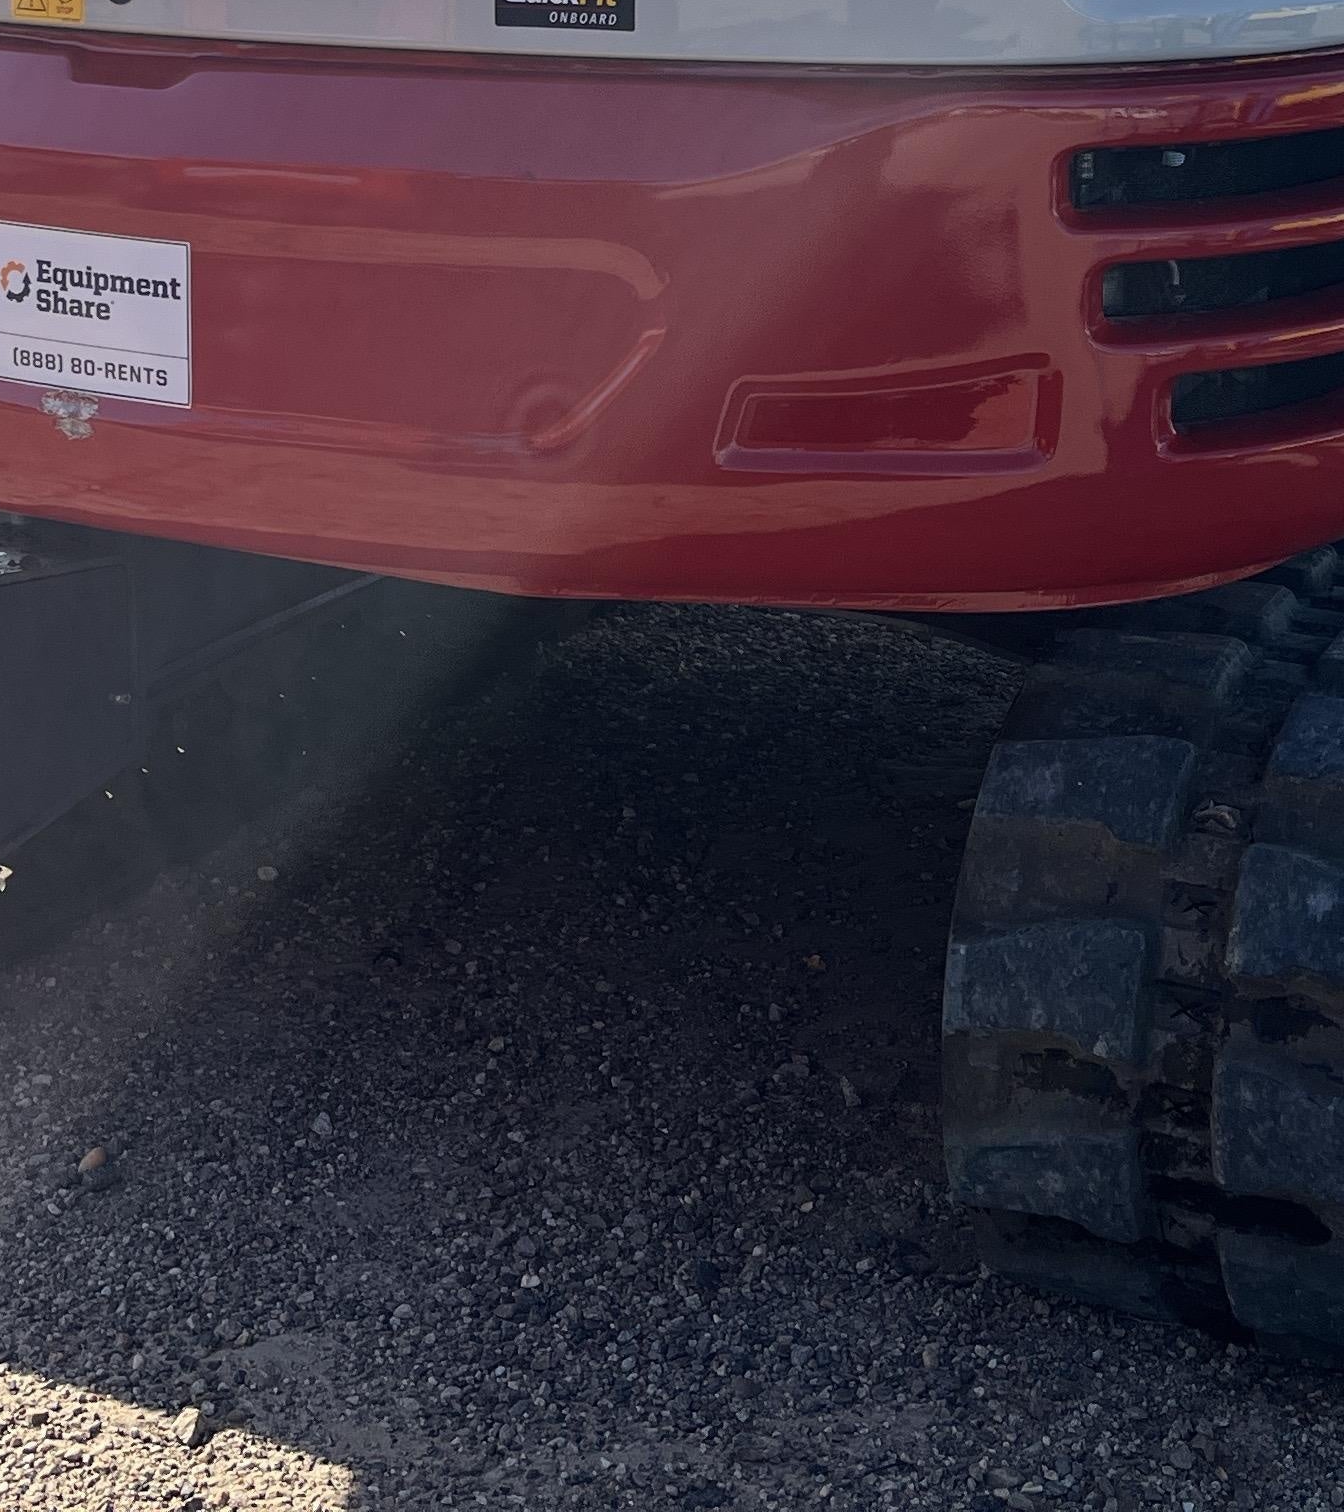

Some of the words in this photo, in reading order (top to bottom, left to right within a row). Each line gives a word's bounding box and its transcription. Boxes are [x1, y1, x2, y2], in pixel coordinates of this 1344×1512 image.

[549, 11, 618, 26] ONBOARD
[36, 259, 182, 301] Equipment
[36, 289, 112, 321] Share
[12, 347, 63, 373] (888)
[70, 357, 168, 388] 80-RENTS
